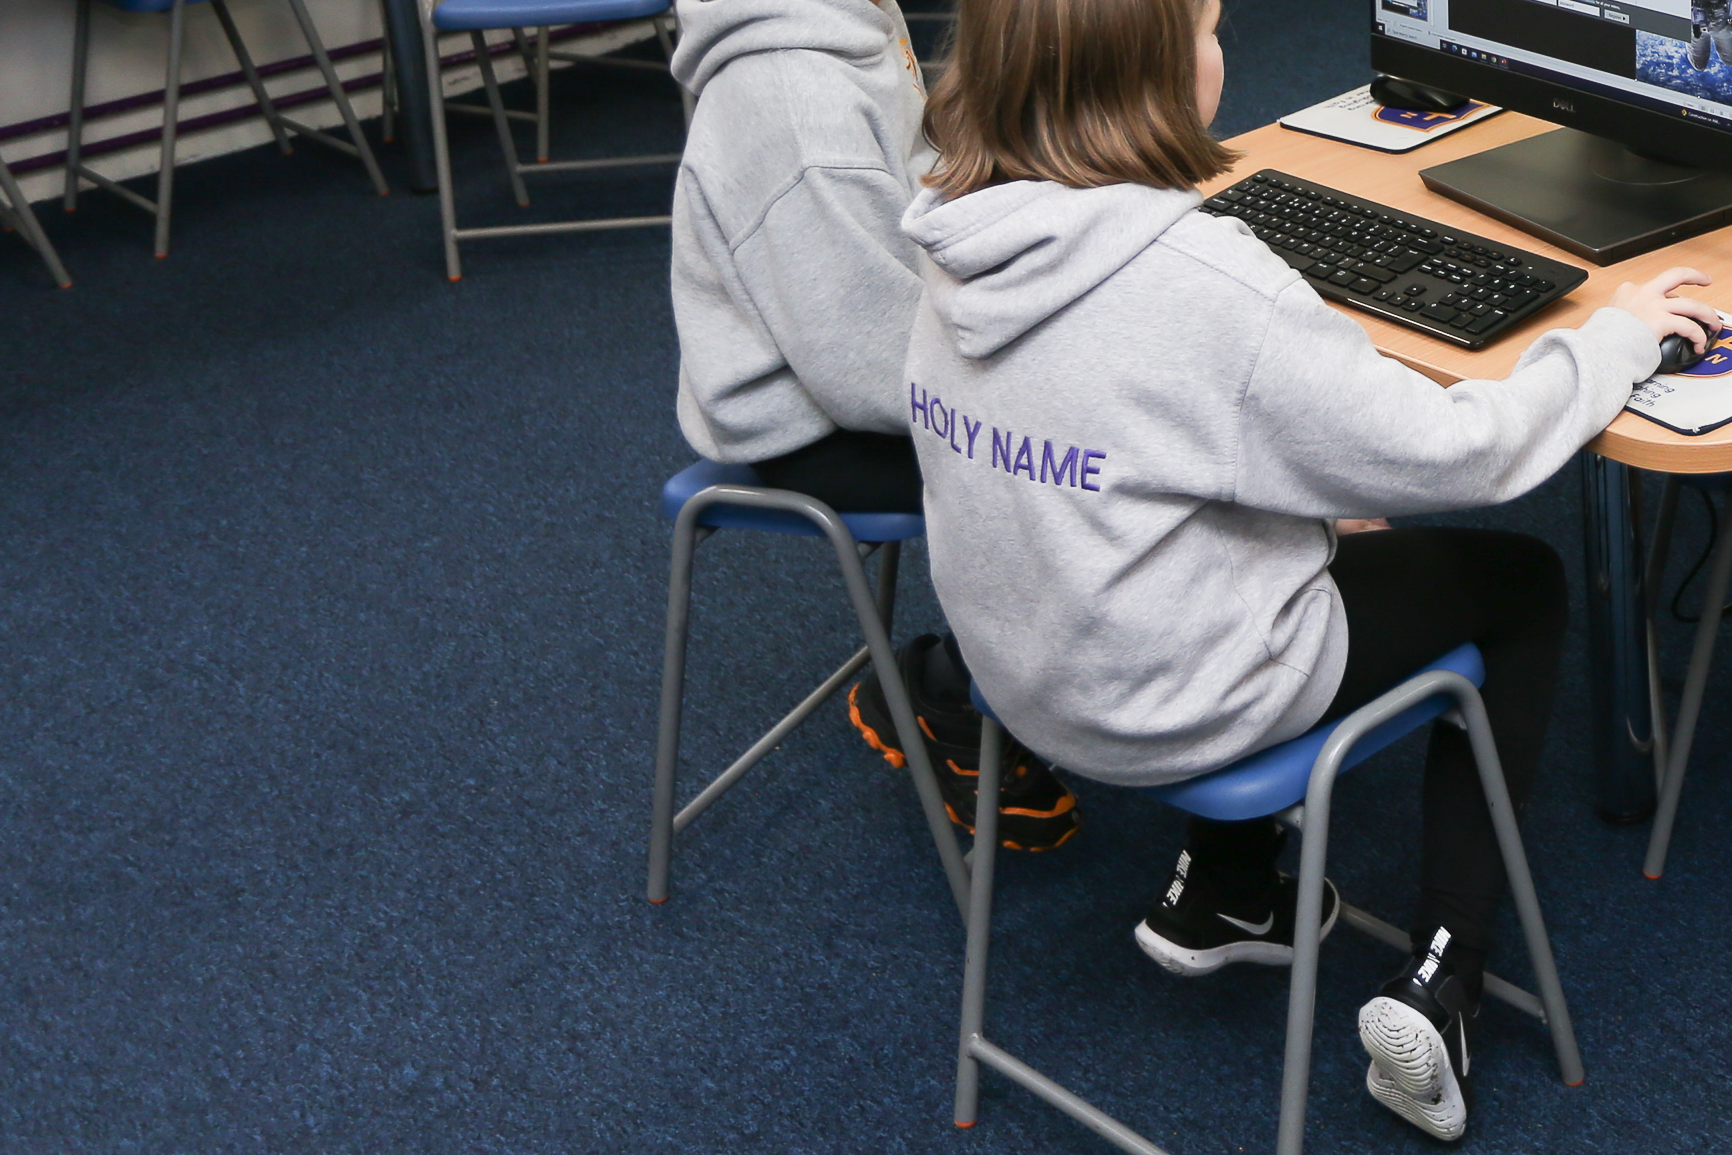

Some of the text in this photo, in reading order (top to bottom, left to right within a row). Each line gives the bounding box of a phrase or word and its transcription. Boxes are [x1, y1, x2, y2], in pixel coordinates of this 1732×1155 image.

[1553, 99, 1576, 113] DELL
[1645, 379, 1676, 393] arning
[911, 382, 1108, 493] HOLY NAME
[1176, 849, 1192, 879] NIKE
[1166, 879, 1184, 906] NIKE
[1430, 926, 1452, 957] NIKE
[1417, 958, 1439, 983] NIKE
